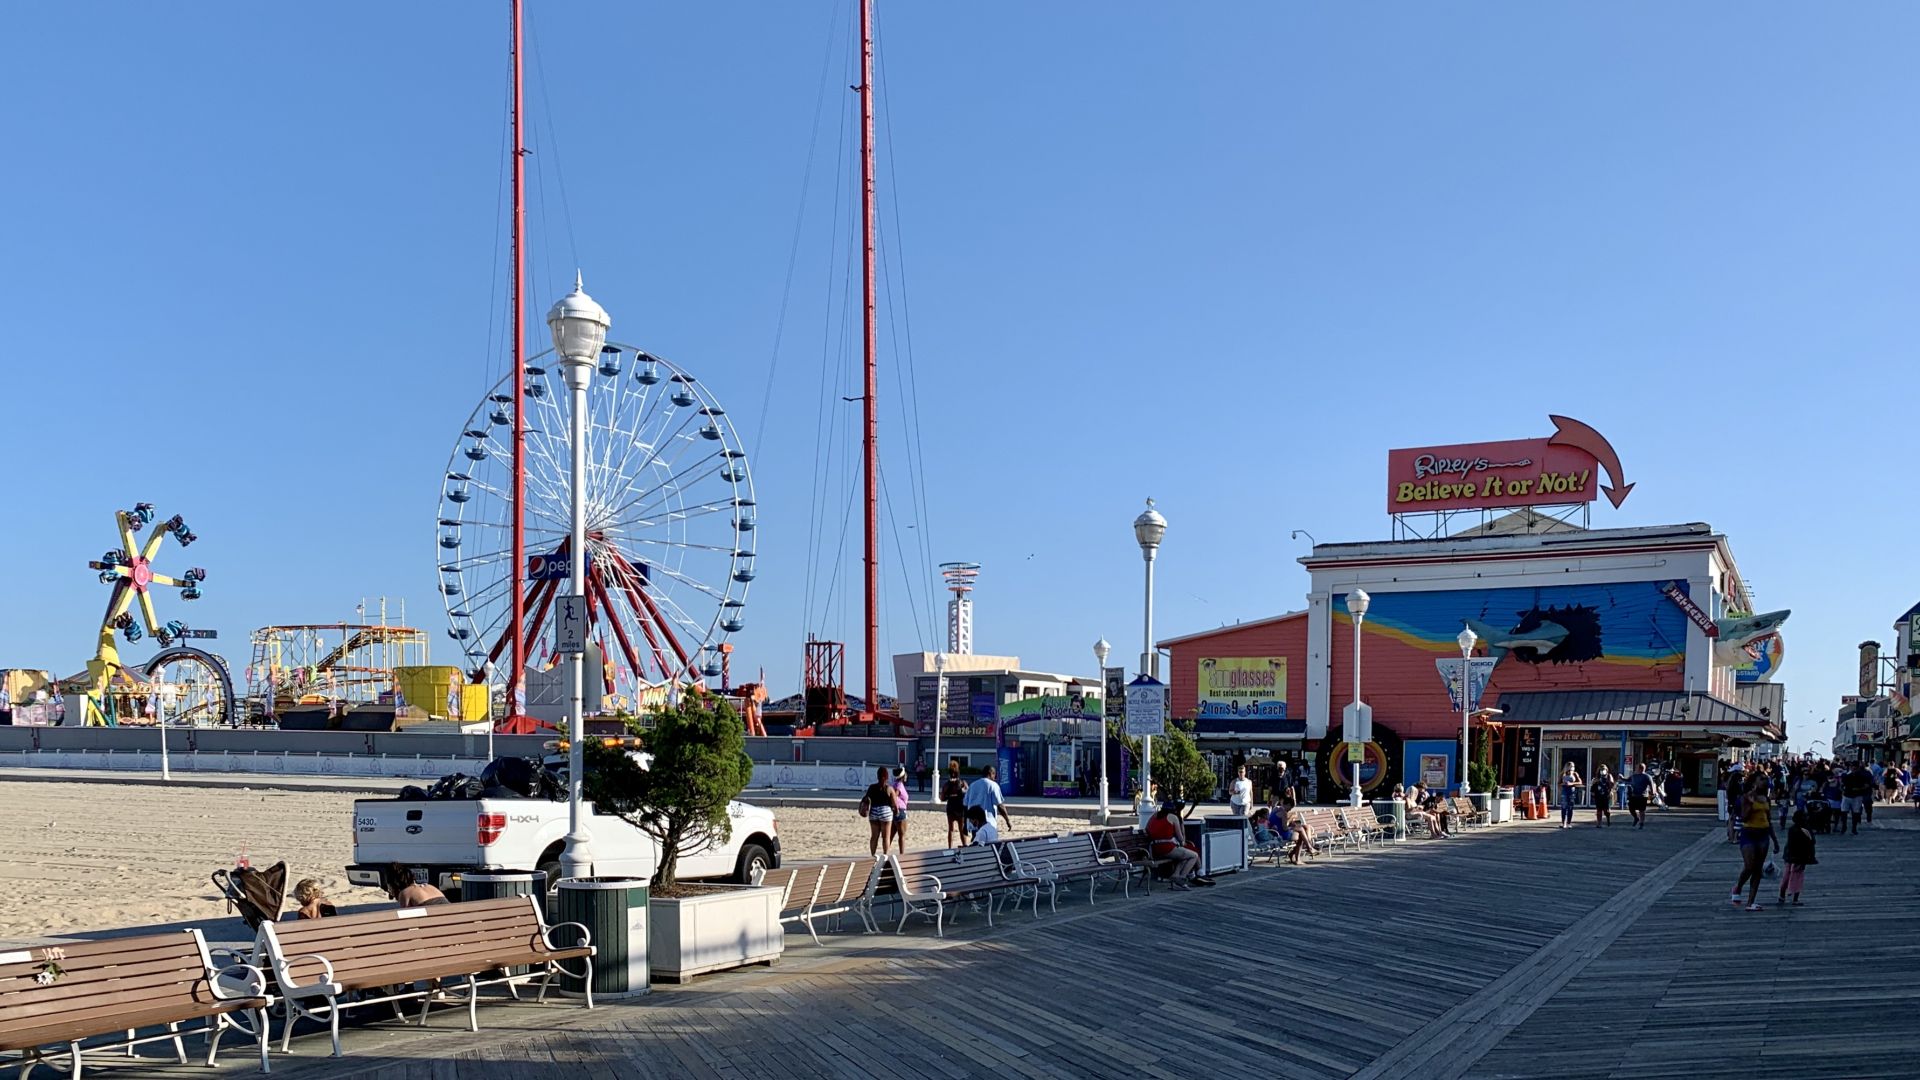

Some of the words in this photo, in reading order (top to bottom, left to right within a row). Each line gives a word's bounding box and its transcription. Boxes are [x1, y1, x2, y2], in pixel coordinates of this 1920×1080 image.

[1396, 481, 1476, 503] Believe
[1481, 476, 1504, 497] It
[1507, 479, 1534, 496] or
[1536, 469, 1590, 494] Not!
[568, 630, 574, 639] 2
[562, 640, 580, 648] miles
[1223, 689, 1247, 697] selection
[1249, 690, 1275, 698] anywhere
[1201, 700, 1208, 715] 2
[1211, 705, 1224, 715] for
[1262, 705, 1284, 715] each
[357, 818, 375, 826] 5430
